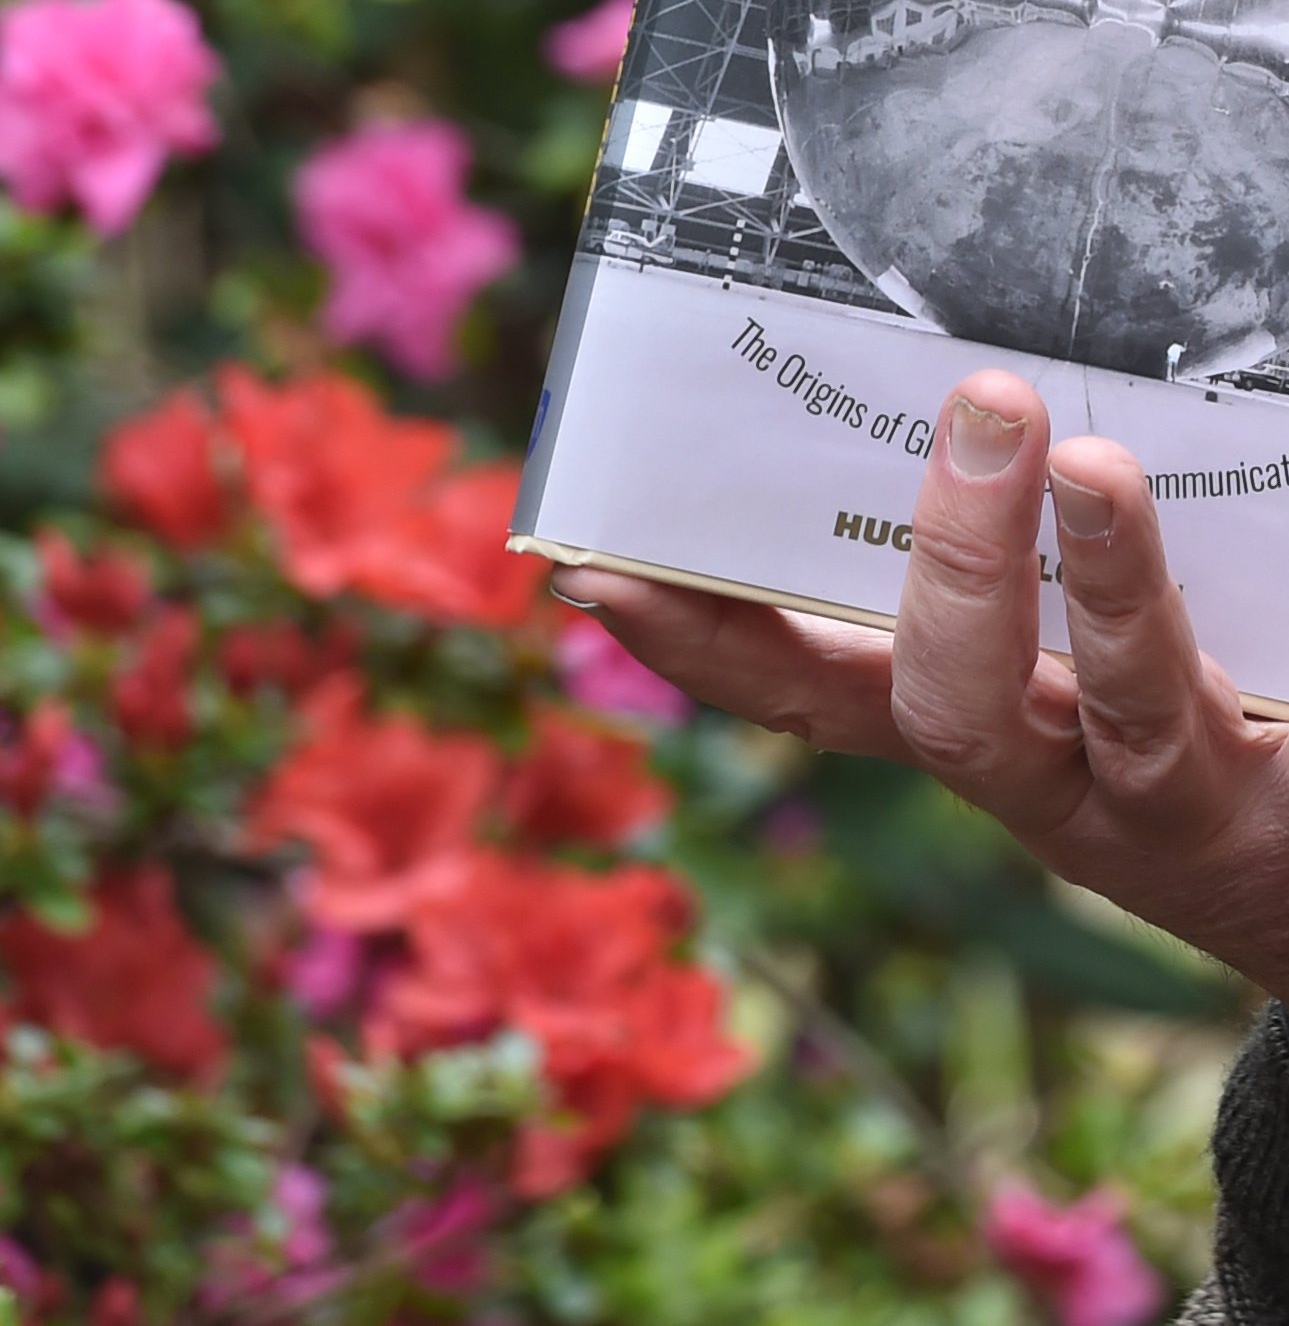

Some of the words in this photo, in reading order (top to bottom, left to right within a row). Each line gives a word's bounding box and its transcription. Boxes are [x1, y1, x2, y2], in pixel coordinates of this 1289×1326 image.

[731, 316, 778, 372] The
[776, 353, 869, 429] Origins
[870, 412, 907, 445] of
[833, 510, 913, 552] HUG
